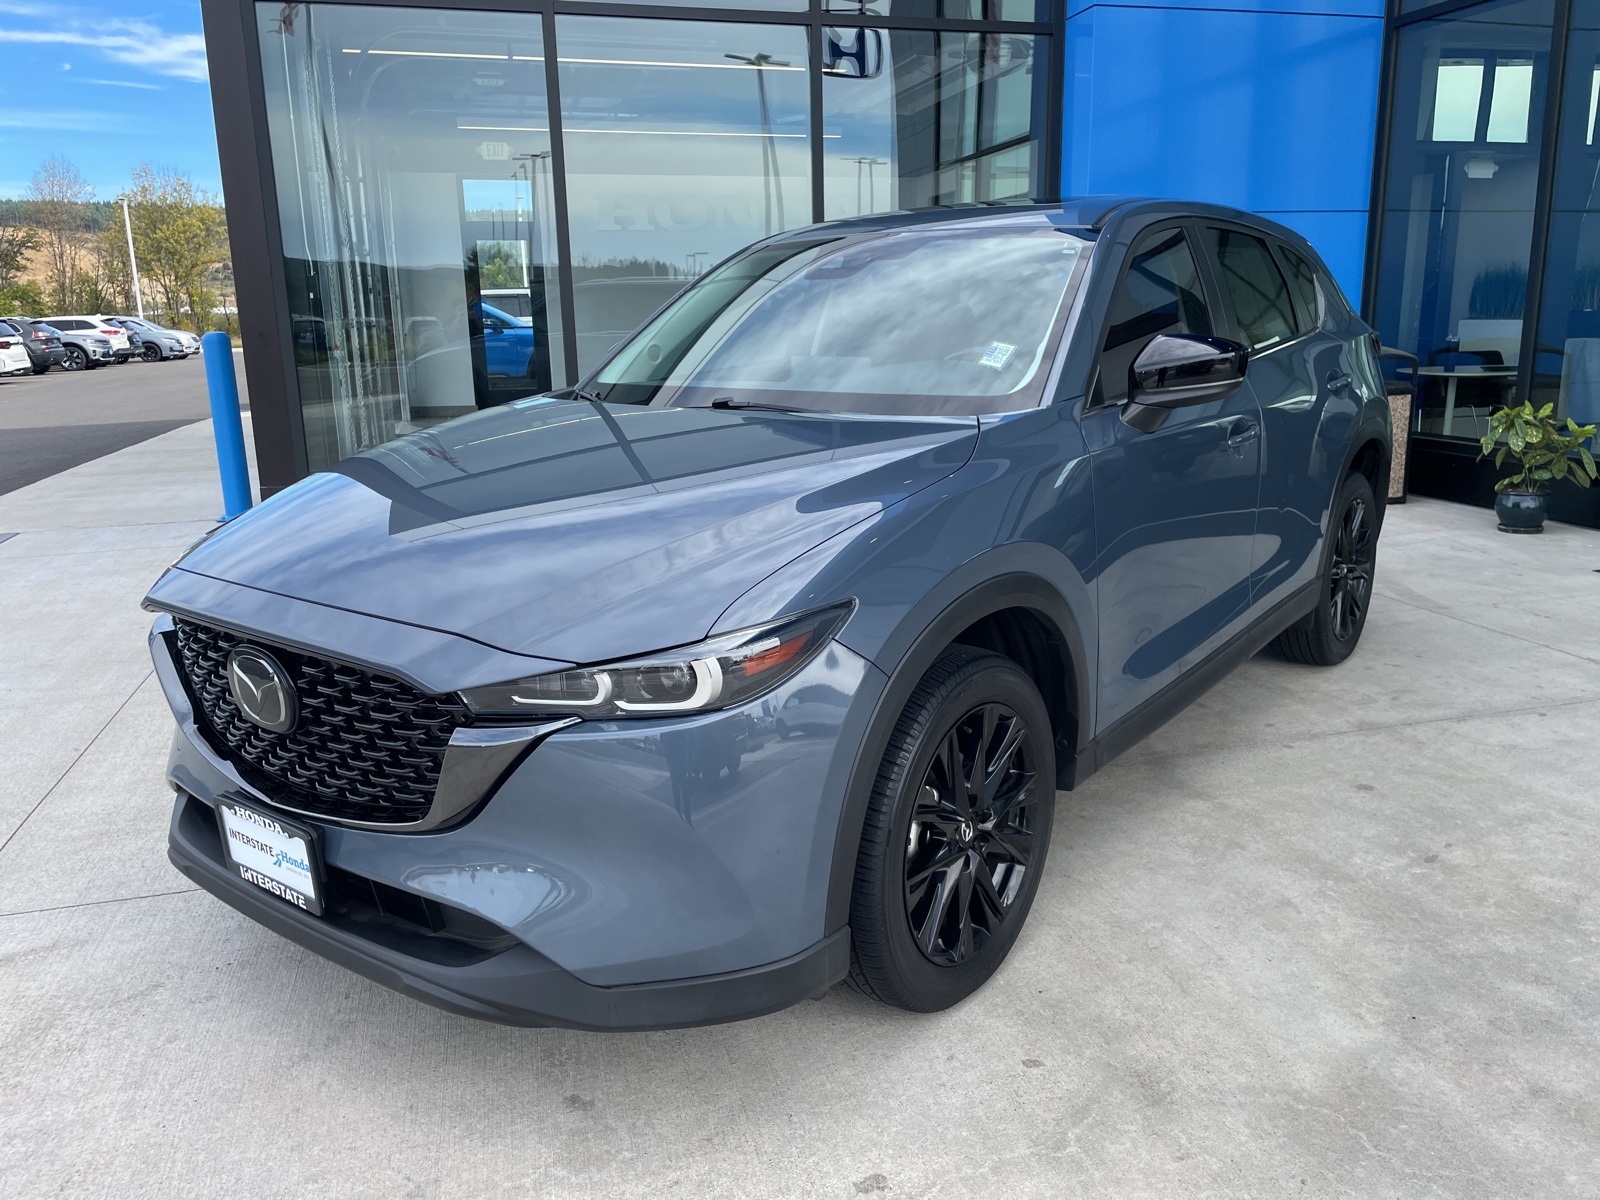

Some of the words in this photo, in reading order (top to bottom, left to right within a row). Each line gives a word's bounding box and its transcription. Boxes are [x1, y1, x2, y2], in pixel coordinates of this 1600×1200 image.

[486, 143, 504, 157] EXIT
[234, 806, 283, 835] HONDA
[229, 827, 274, 858] INTERSTATE
[280, 850, 311, 873] Honda
[240, 866, 307, 910] INTERSTATE
